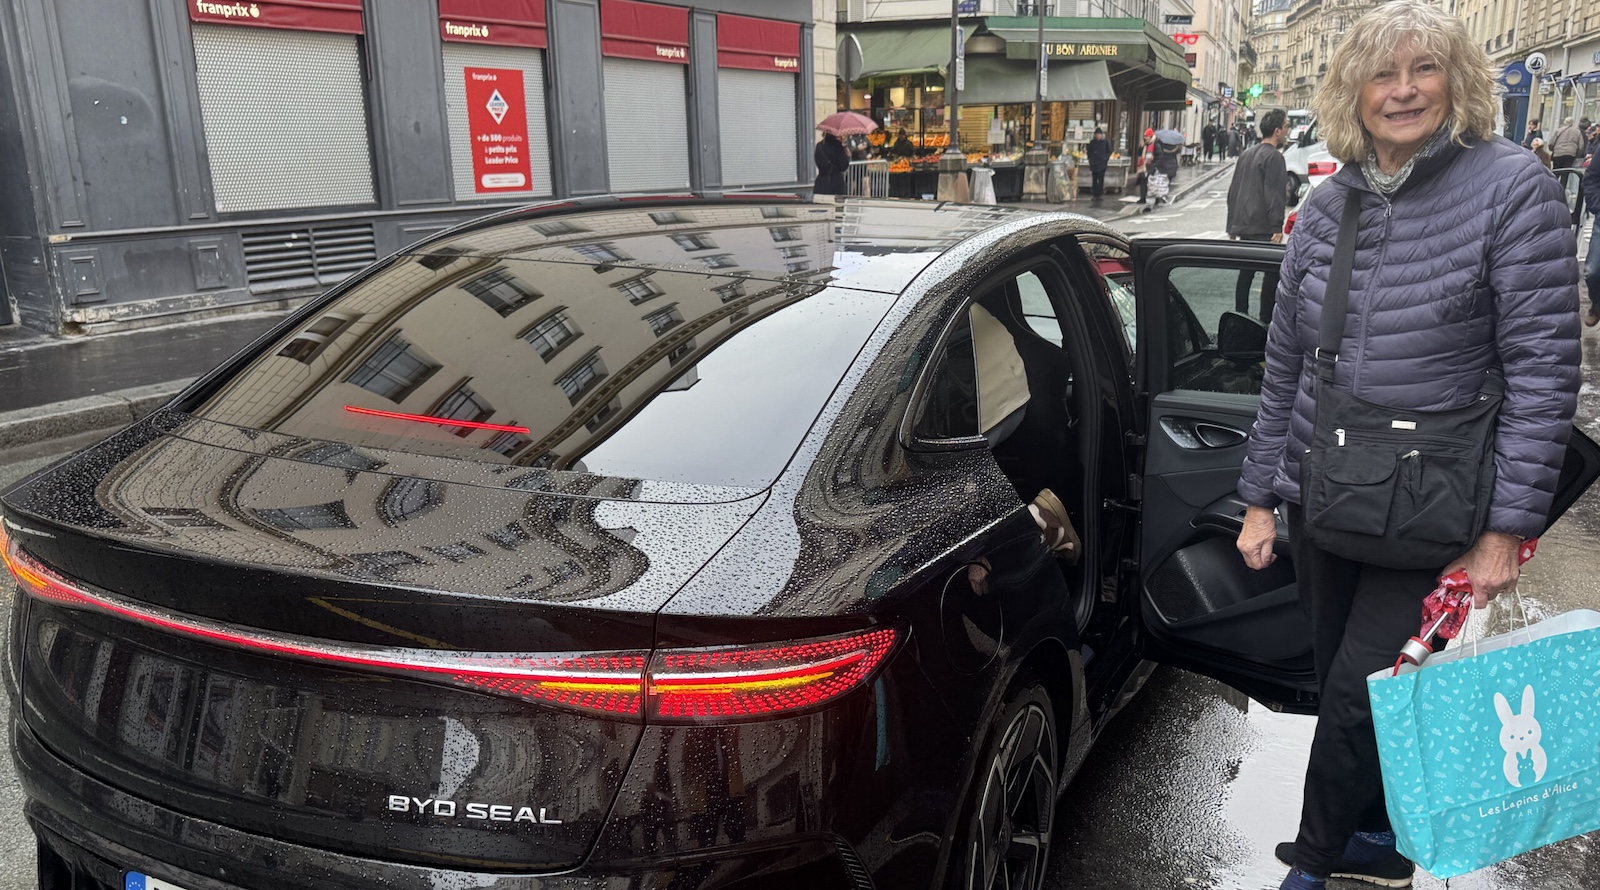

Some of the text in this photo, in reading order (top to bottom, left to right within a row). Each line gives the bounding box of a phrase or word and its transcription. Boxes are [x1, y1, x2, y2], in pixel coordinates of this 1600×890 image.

[196, 0, 249, 18] franprix
[445, 21, 481, 37] franprix
[656, 46, 680, 59] franprix
[1056, 44, 1075, 56] BON
[774, 57, 794, 69] franprix
[472, 72, 494, 82] franprix
[482, 134, 490, 142] de
[502, 134, 522, 143] produits
[489, 145, 505, 155] petits
[505, 145, 517, 155] prix
[485, 156, 519, 165] Leader Price
[1479, 782, 1578, 818] Les Lapins d'Alice
[389, 794, 563, 824] BYD SEAL
[1511, 804, 1547, 820] PARIS
